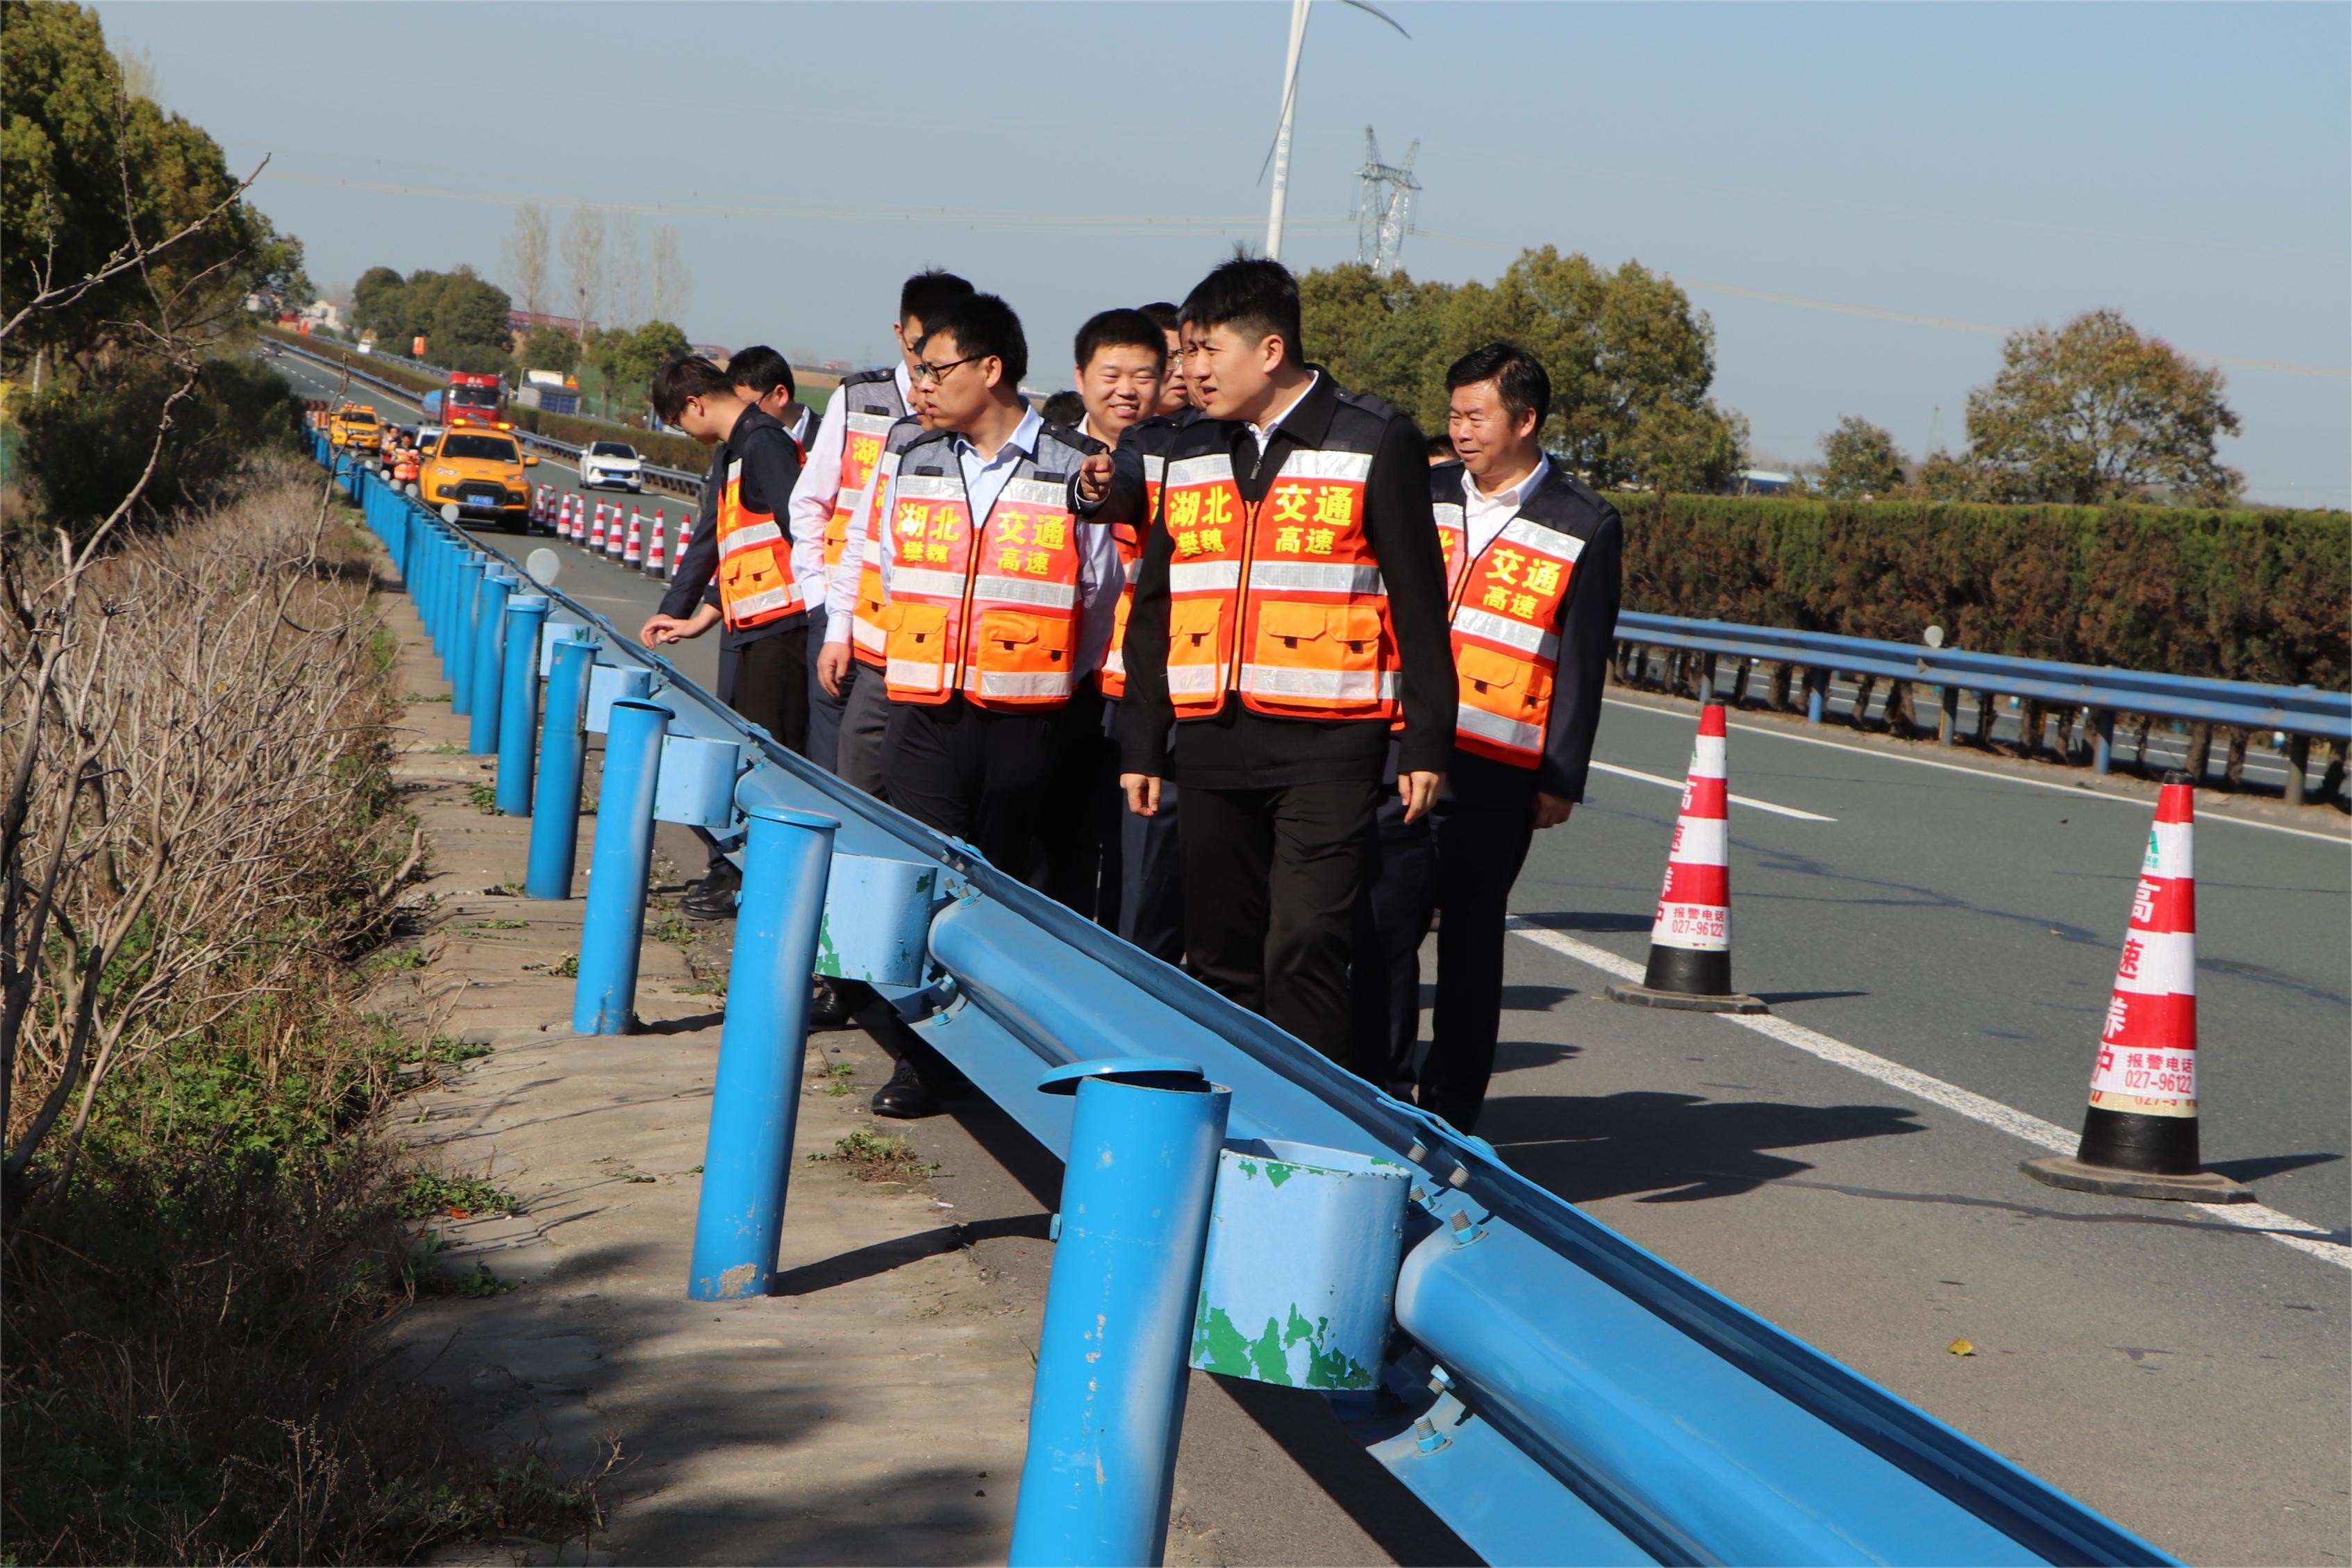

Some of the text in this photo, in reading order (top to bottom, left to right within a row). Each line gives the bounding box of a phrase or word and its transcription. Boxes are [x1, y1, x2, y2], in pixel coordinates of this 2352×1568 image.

[1169, 485, 1233, 528] 湖北
[1272, 483, 1354, 526] 交通
[894, 502, 962, 542] 湖北
[994, 509, 1066, 551] 交通
[1176, 526, 1336, 558] 樊魏 高速
[902, 540, 1051, 576] 樊魏 高速
[1485, 549, 1563, 597] 交通
[1483, 585, 1540, 620] 高速
[1672, 907, 1725, 922] 报警电话
[1672, 919, 1724, 937] 027-96122
[2126, 1053, 2194, 1074] 报警电话
[2125, 1070, 2192, 1094] 027-96122
